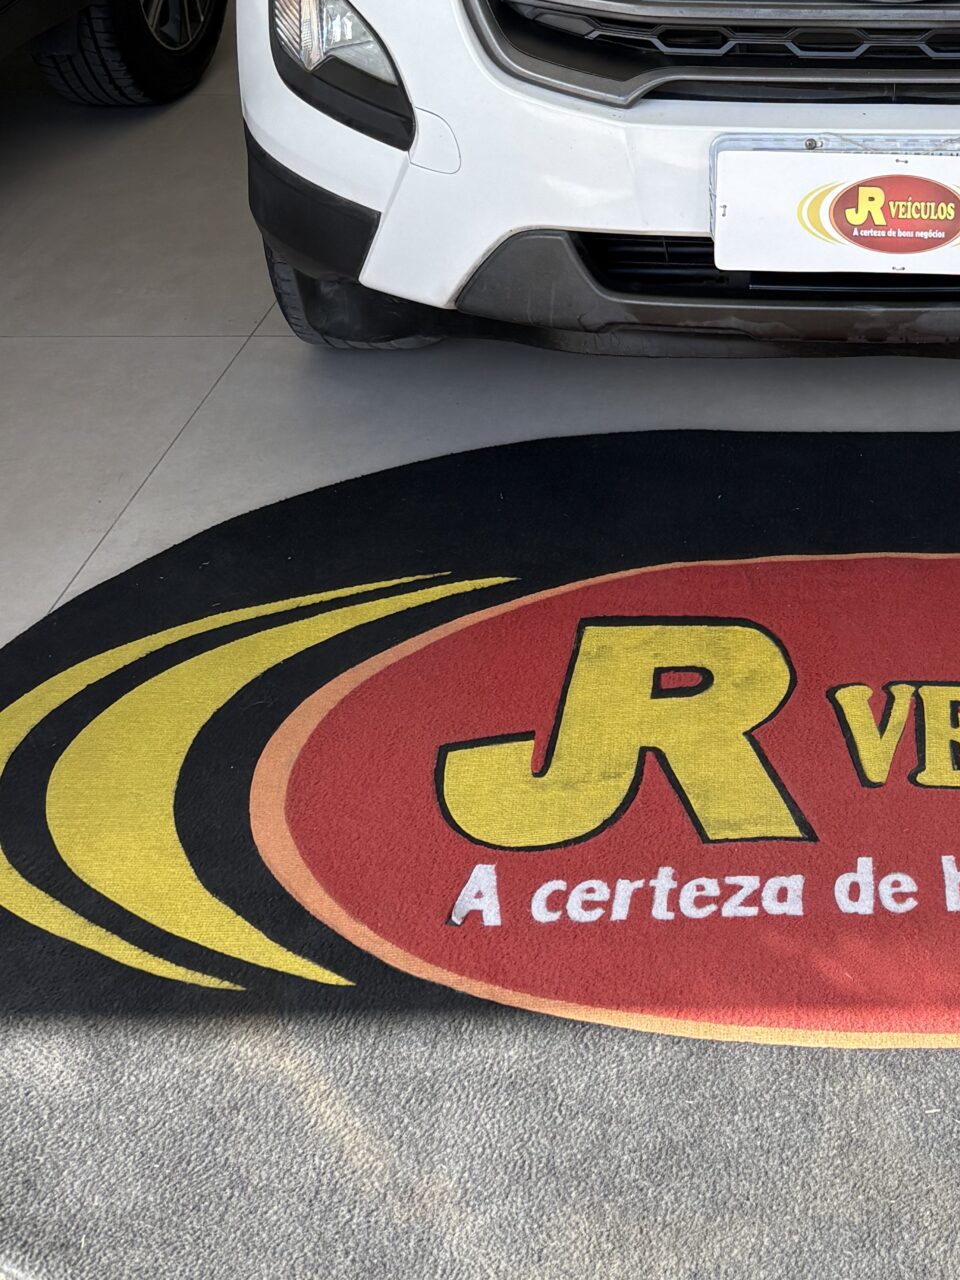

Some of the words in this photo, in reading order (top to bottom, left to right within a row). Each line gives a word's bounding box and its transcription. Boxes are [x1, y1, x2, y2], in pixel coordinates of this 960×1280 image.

[844, 185, 887, 226] JR
[888, 196, 956, 221] VEÍCULOS
[852, 227, 859, 237] A
[860, 228, 886, 238] certeza
[887, 228, 897, 238] de
[897, 228, 914, 238] bons
[915, 228, 946, 240] negócios
[435, 617, 818, 852] JR
[447, 863, 501, 927] A
[531, 866, 806, 924] certeza
[833, 856, 919, 916] de
